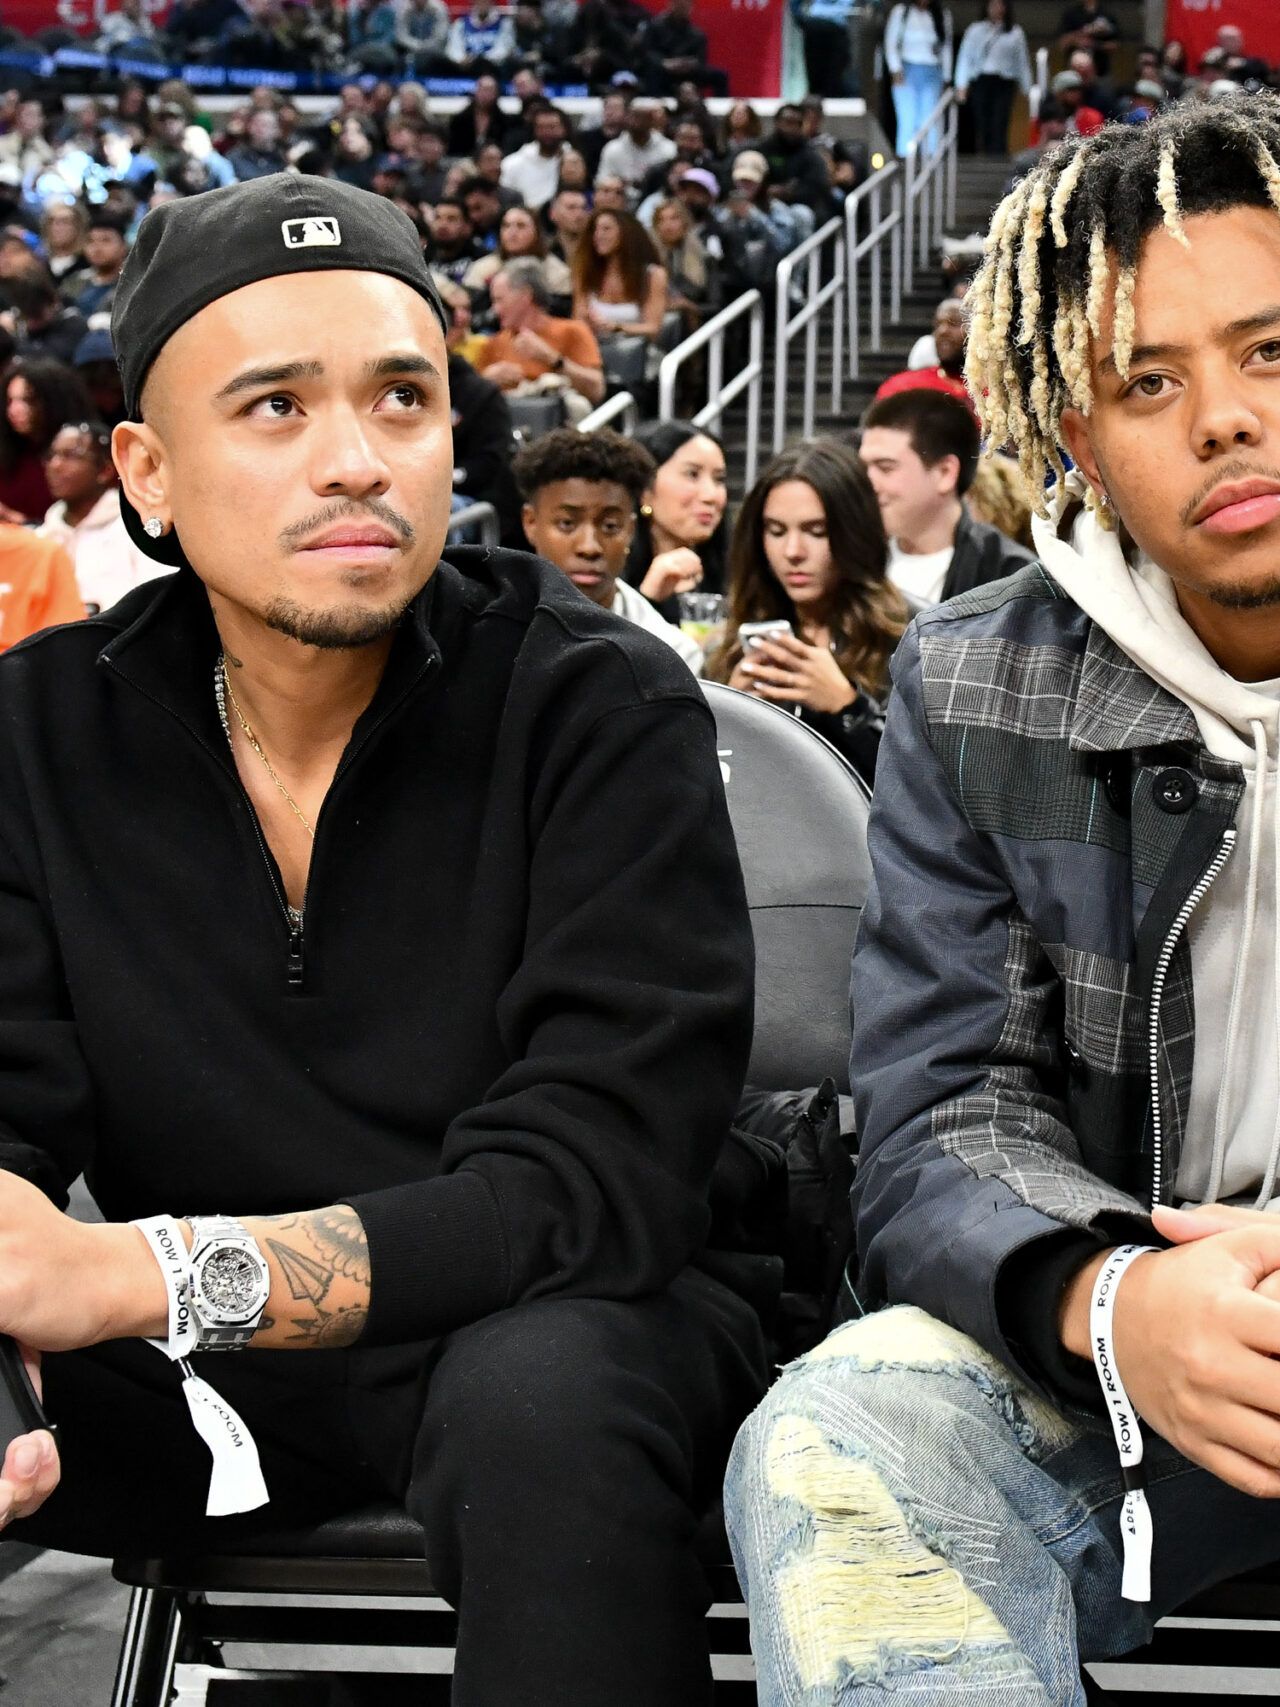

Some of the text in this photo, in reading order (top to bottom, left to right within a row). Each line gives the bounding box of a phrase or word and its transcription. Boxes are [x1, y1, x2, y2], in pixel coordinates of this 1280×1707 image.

[155, 1228, 179, 1261] ROW
[175, 1282, 190, 1336] OOM
[1097, 1268, 1116, 1307] ROW
[1096, 1337, 1117, 1393] ROOM
[1117, 1412, 1132, 1454] ROW
